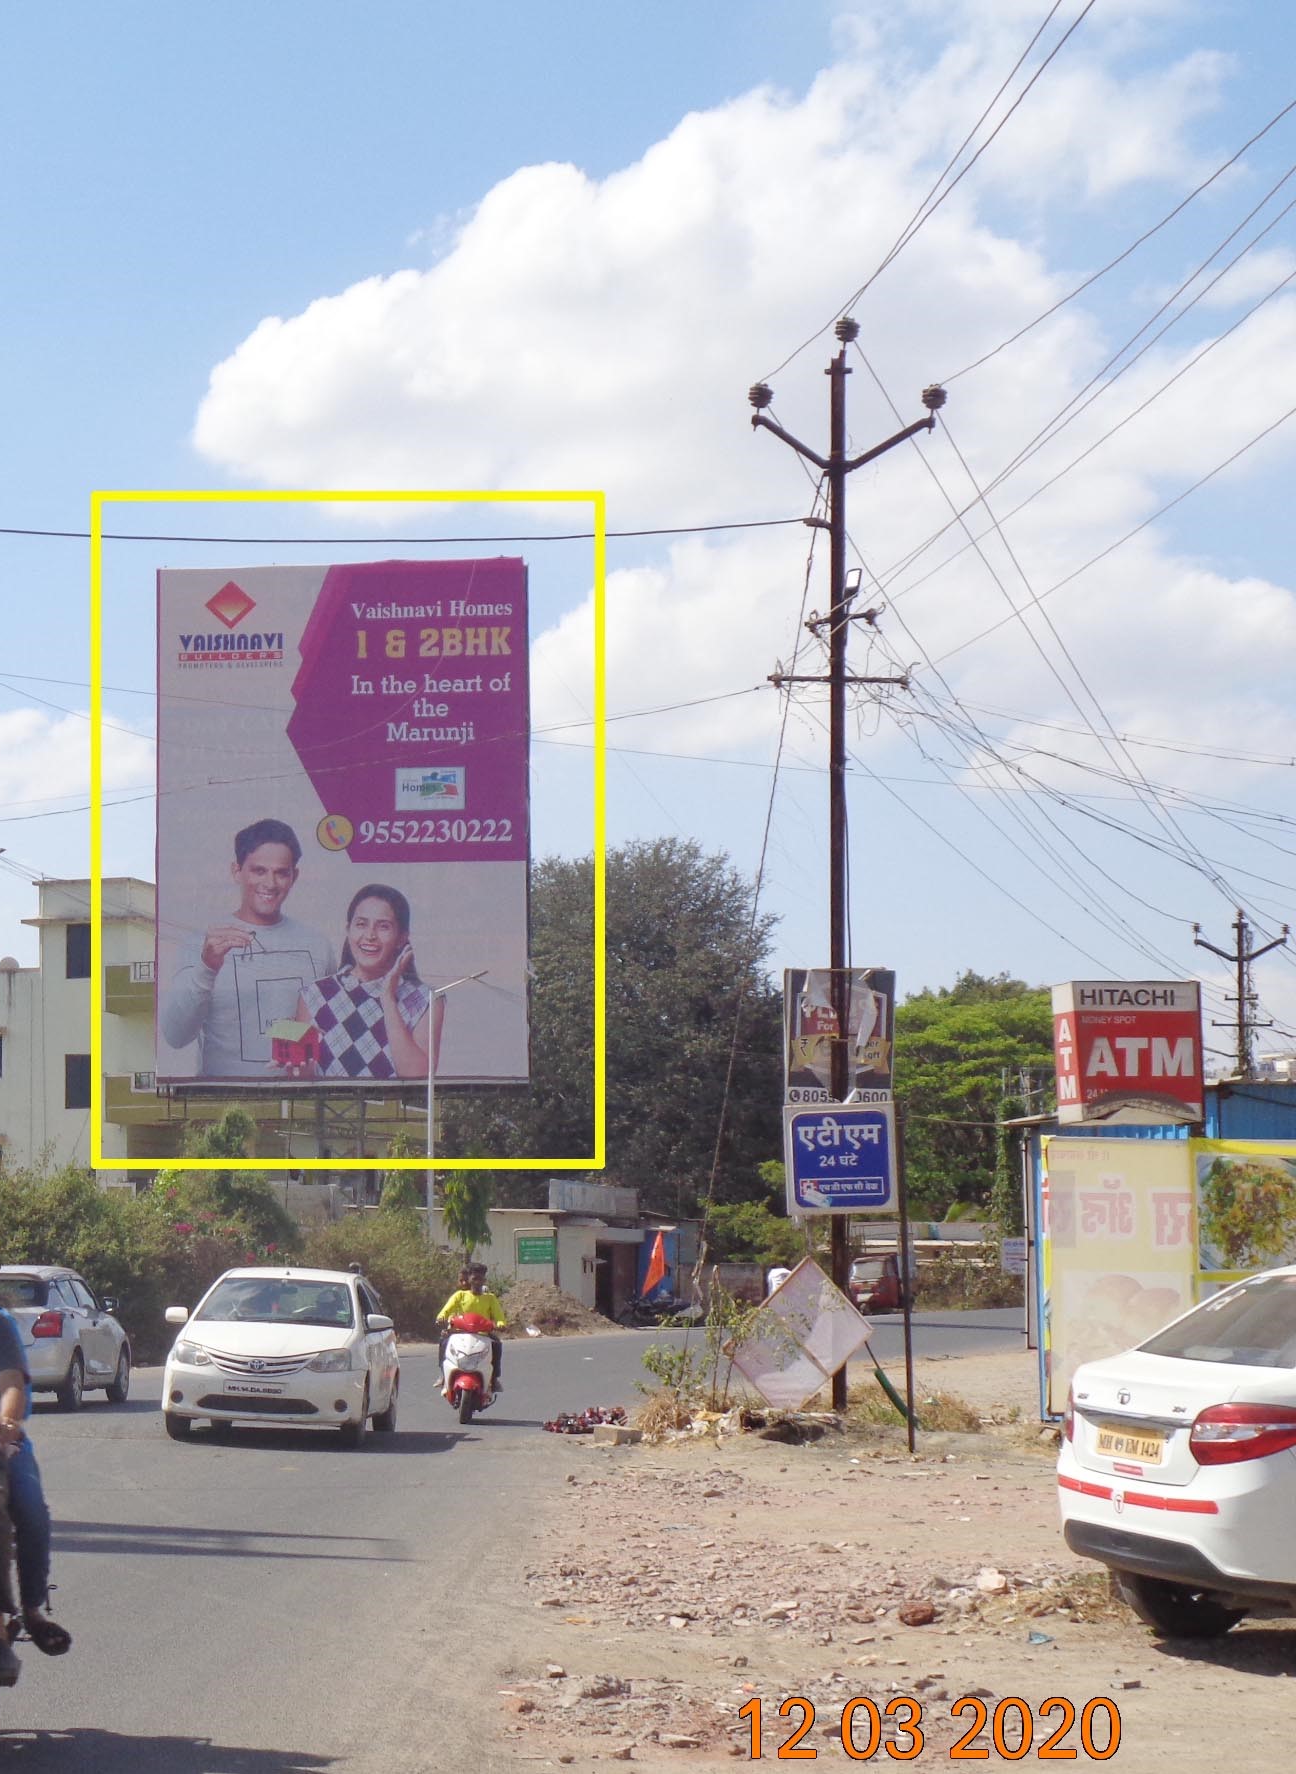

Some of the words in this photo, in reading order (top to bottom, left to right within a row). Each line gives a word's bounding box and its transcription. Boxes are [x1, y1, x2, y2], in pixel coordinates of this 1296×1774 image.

[352, 601, 442, 619] Vaishnavi
[449, 600, 513, 616] Homes
[179, 633, 283, 651] VAISHNAVI
[357, 630, 368, 659] 1
[385, 629, 406, 658] &
[419, 627, 512, 657] 2BHK
[180, 651, 283, 661] BUILDERS
[352, 675, 374, 694] In
[381, 675, 417, 694] the
[424, 674, 482, 693] heart
[489, 672, 511, 691] of
[413, 698, 449, 717] the
[386, 722, 475, 744] Marunji
[359, 819, 513, 844] 9552230222
[1080, 989, 1175, 1006] HITACHI
[817, 1021, 834, 1031] For
[1113, 1016, 1137, 1024] SPOT
[1058, 1018, 1077, 1100] ATM
[1086, 1037, 1194, 1077] ATM
[819, 1155, 836, 1167] 24
[839, 1152, 859, 1166] घंटे
